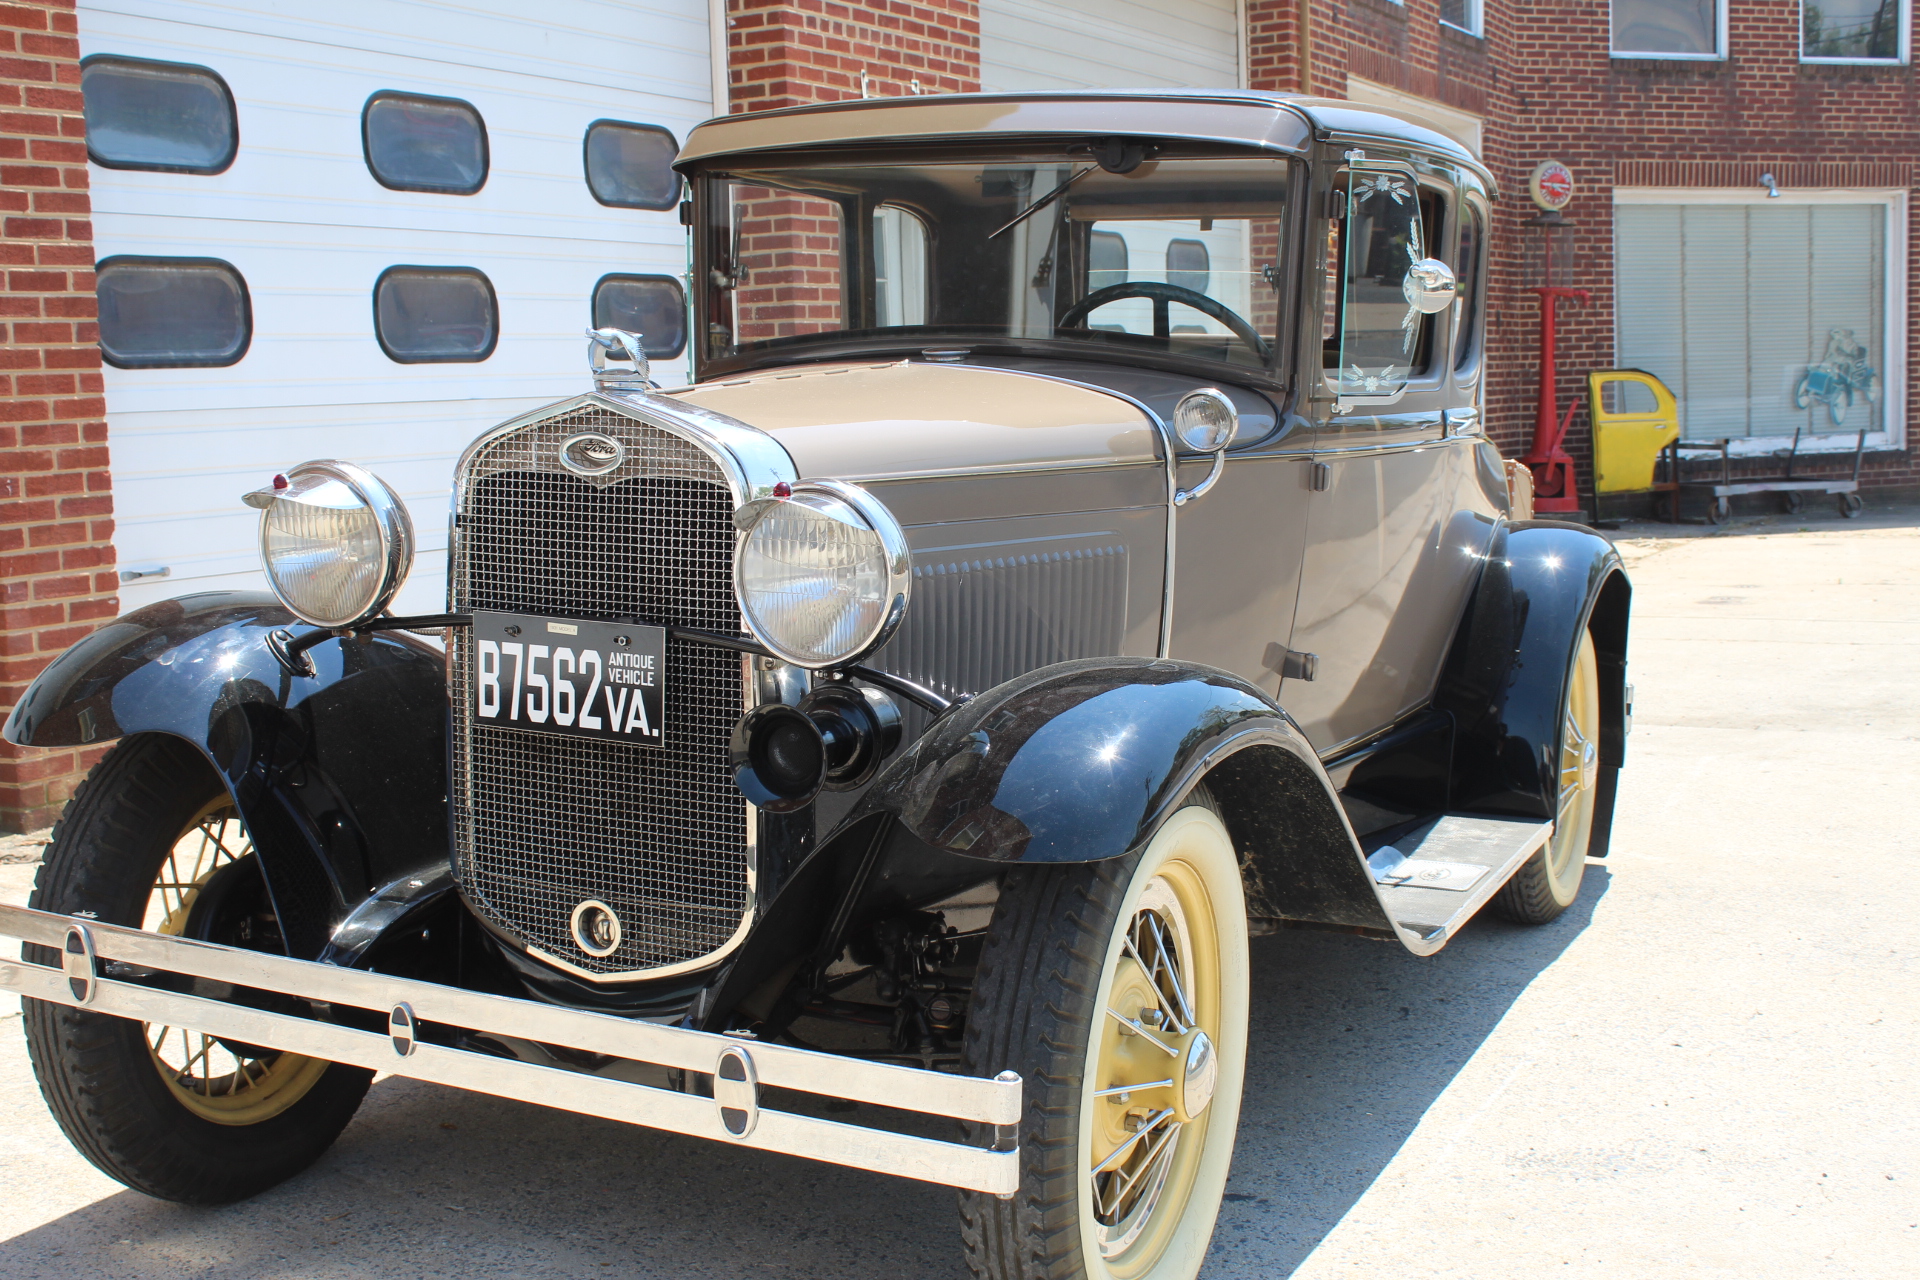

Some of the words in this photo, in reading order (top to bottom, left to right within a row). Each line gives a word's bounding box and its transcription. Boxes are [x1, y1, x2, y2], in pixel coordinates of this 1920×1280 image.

[608, 651, 655, 670] ANTIQUE
[608, 667, 655, 687] VEHICLE
[478, 639, 602, 730] B7562
[604, 685, 659, 737] VA.
